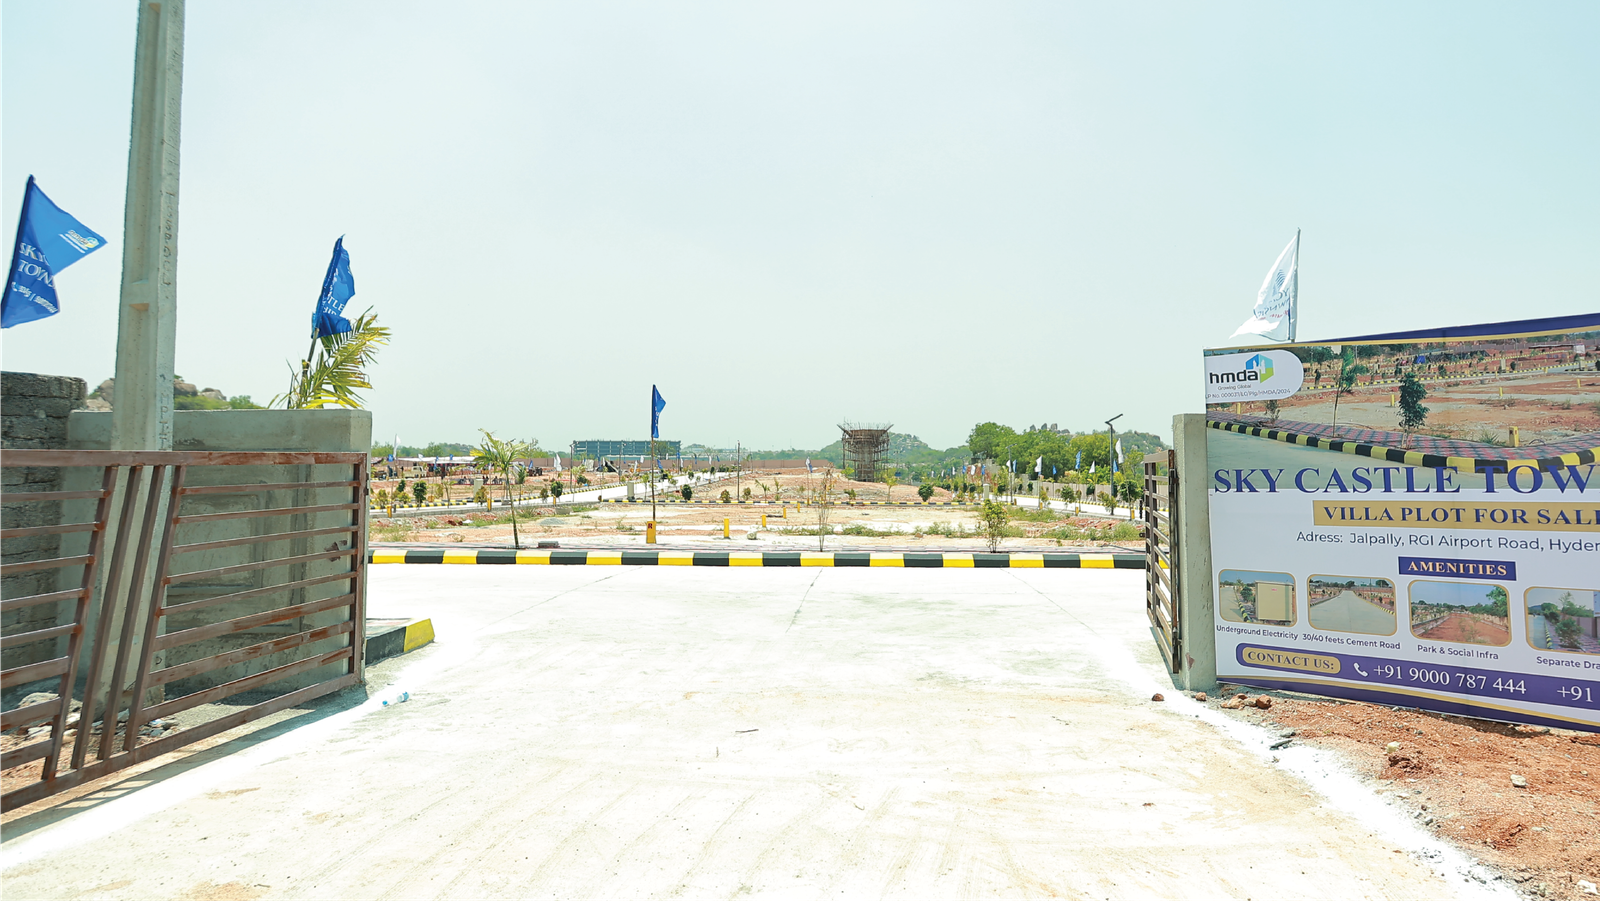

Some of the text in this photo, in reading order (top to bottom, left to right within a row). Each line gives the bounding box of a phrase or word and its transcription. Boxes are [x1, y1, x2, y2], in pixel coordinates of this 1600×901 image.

[1209, 369, 1259, 384] hmda
[1214, 468, 1285, 493] SKY
[1294, 466, 1461, 494] CASTLE
[1323, 507, 1395, 521] VILLA
[1400, 507, 1466, 523] PLOT
[1473, 508, 1530, 524] FOR
[1296, 531, 1343, 543] Adress:
[1349, 532, 1405, 547] Jalpally,
[1409, 534, 1434, 546] RGI
[1438, 535, 1493, 549] Airport
[1498, 537, 1544, 551] Road,
[1407, 561, 1508, 576] AMENITIES
[1216, 625, 1299, 641] Underground Electricity
[1302, 633, 1401, 650] 30/40 feets Cement Road
[1417, 644, 1499, 660] Park & Social Infra
[1247, 651, 1335, 670] CONTACT US:
[1536, 656, 1581, 668] Separate
[1373, 664, 1527, 694] +91 9000 787 444
[1556, 686, 1594, 702] +91
